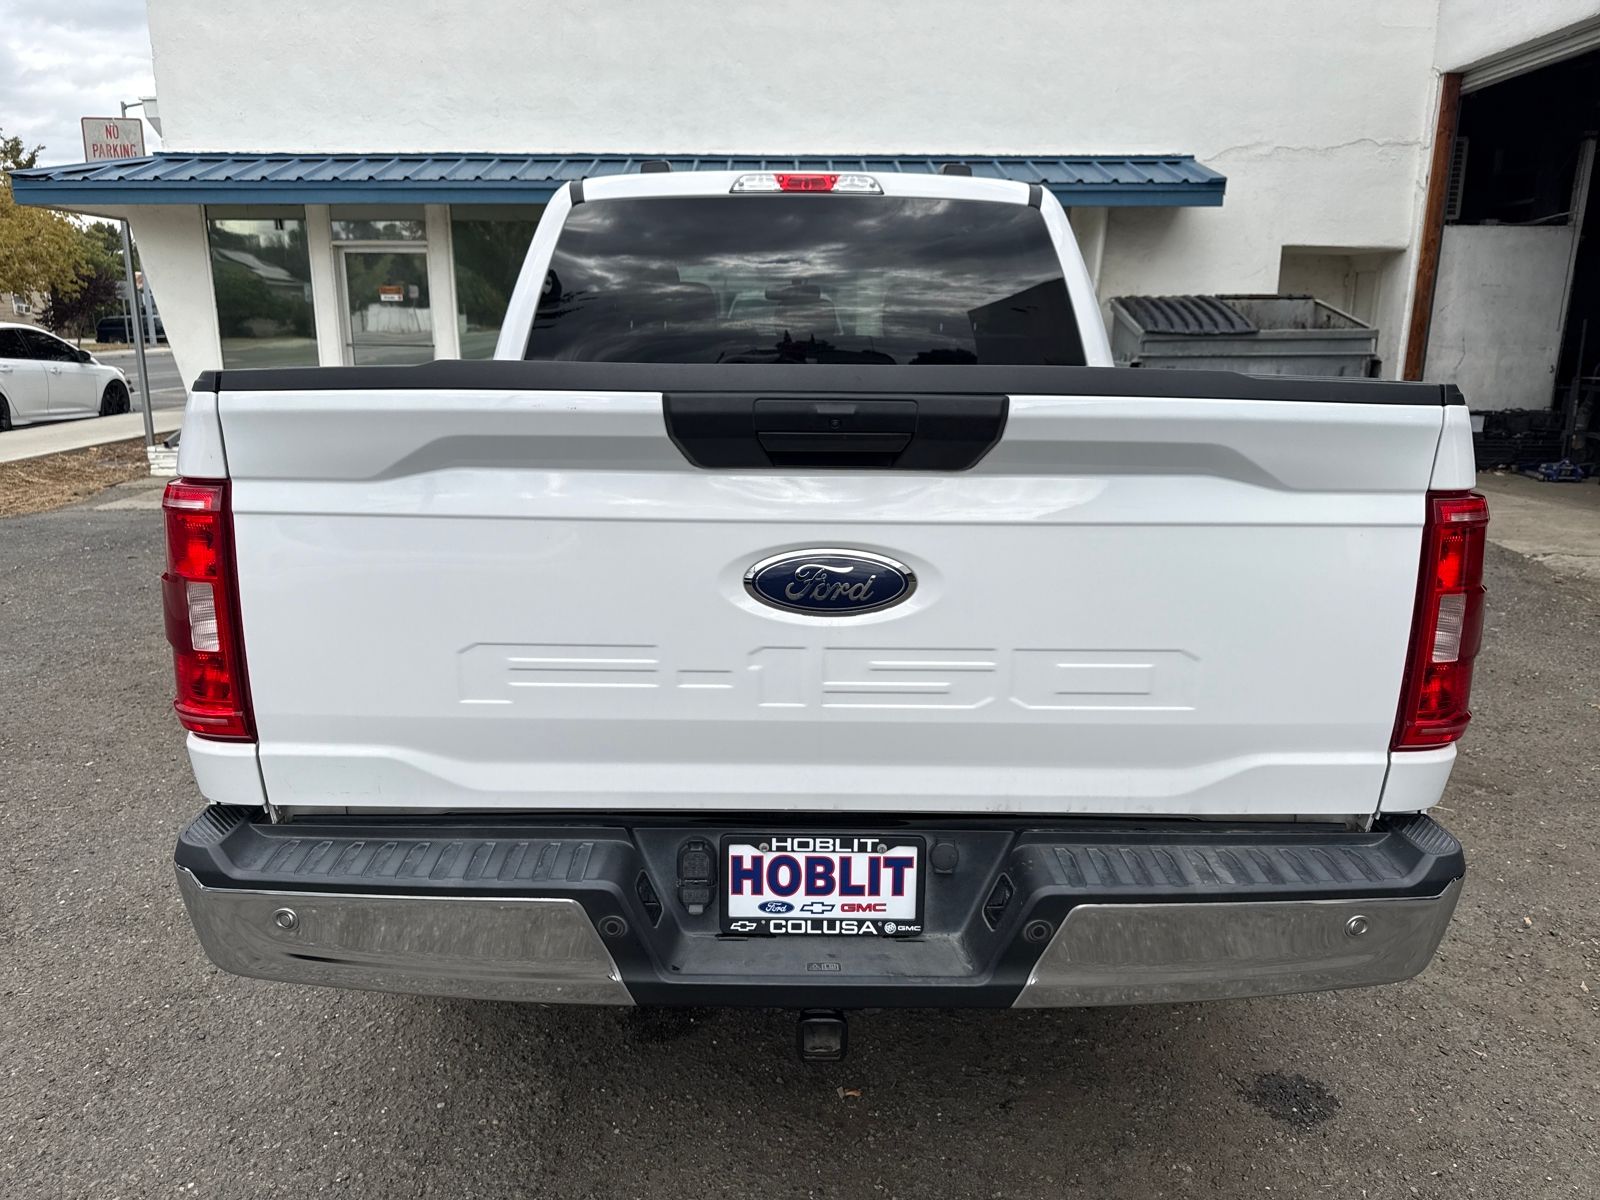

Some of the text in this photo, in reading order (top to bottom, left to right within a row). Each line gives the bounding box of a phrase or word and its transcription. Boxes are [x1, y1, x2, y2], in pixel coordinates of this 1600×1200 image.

[105, 124, 119, 140] NO
[92, 143, 137, 158] PARKING
[785, 563, 877, 602] Ford
[457, 642, 1201, 710] F-150
[771, 837, 880, 852] HOBLIT
[730, 854, 915, 897] HOBLIT
[765, 901, 887, 913] Ford GMC
[769, 919, 878, 935] COLUSA
